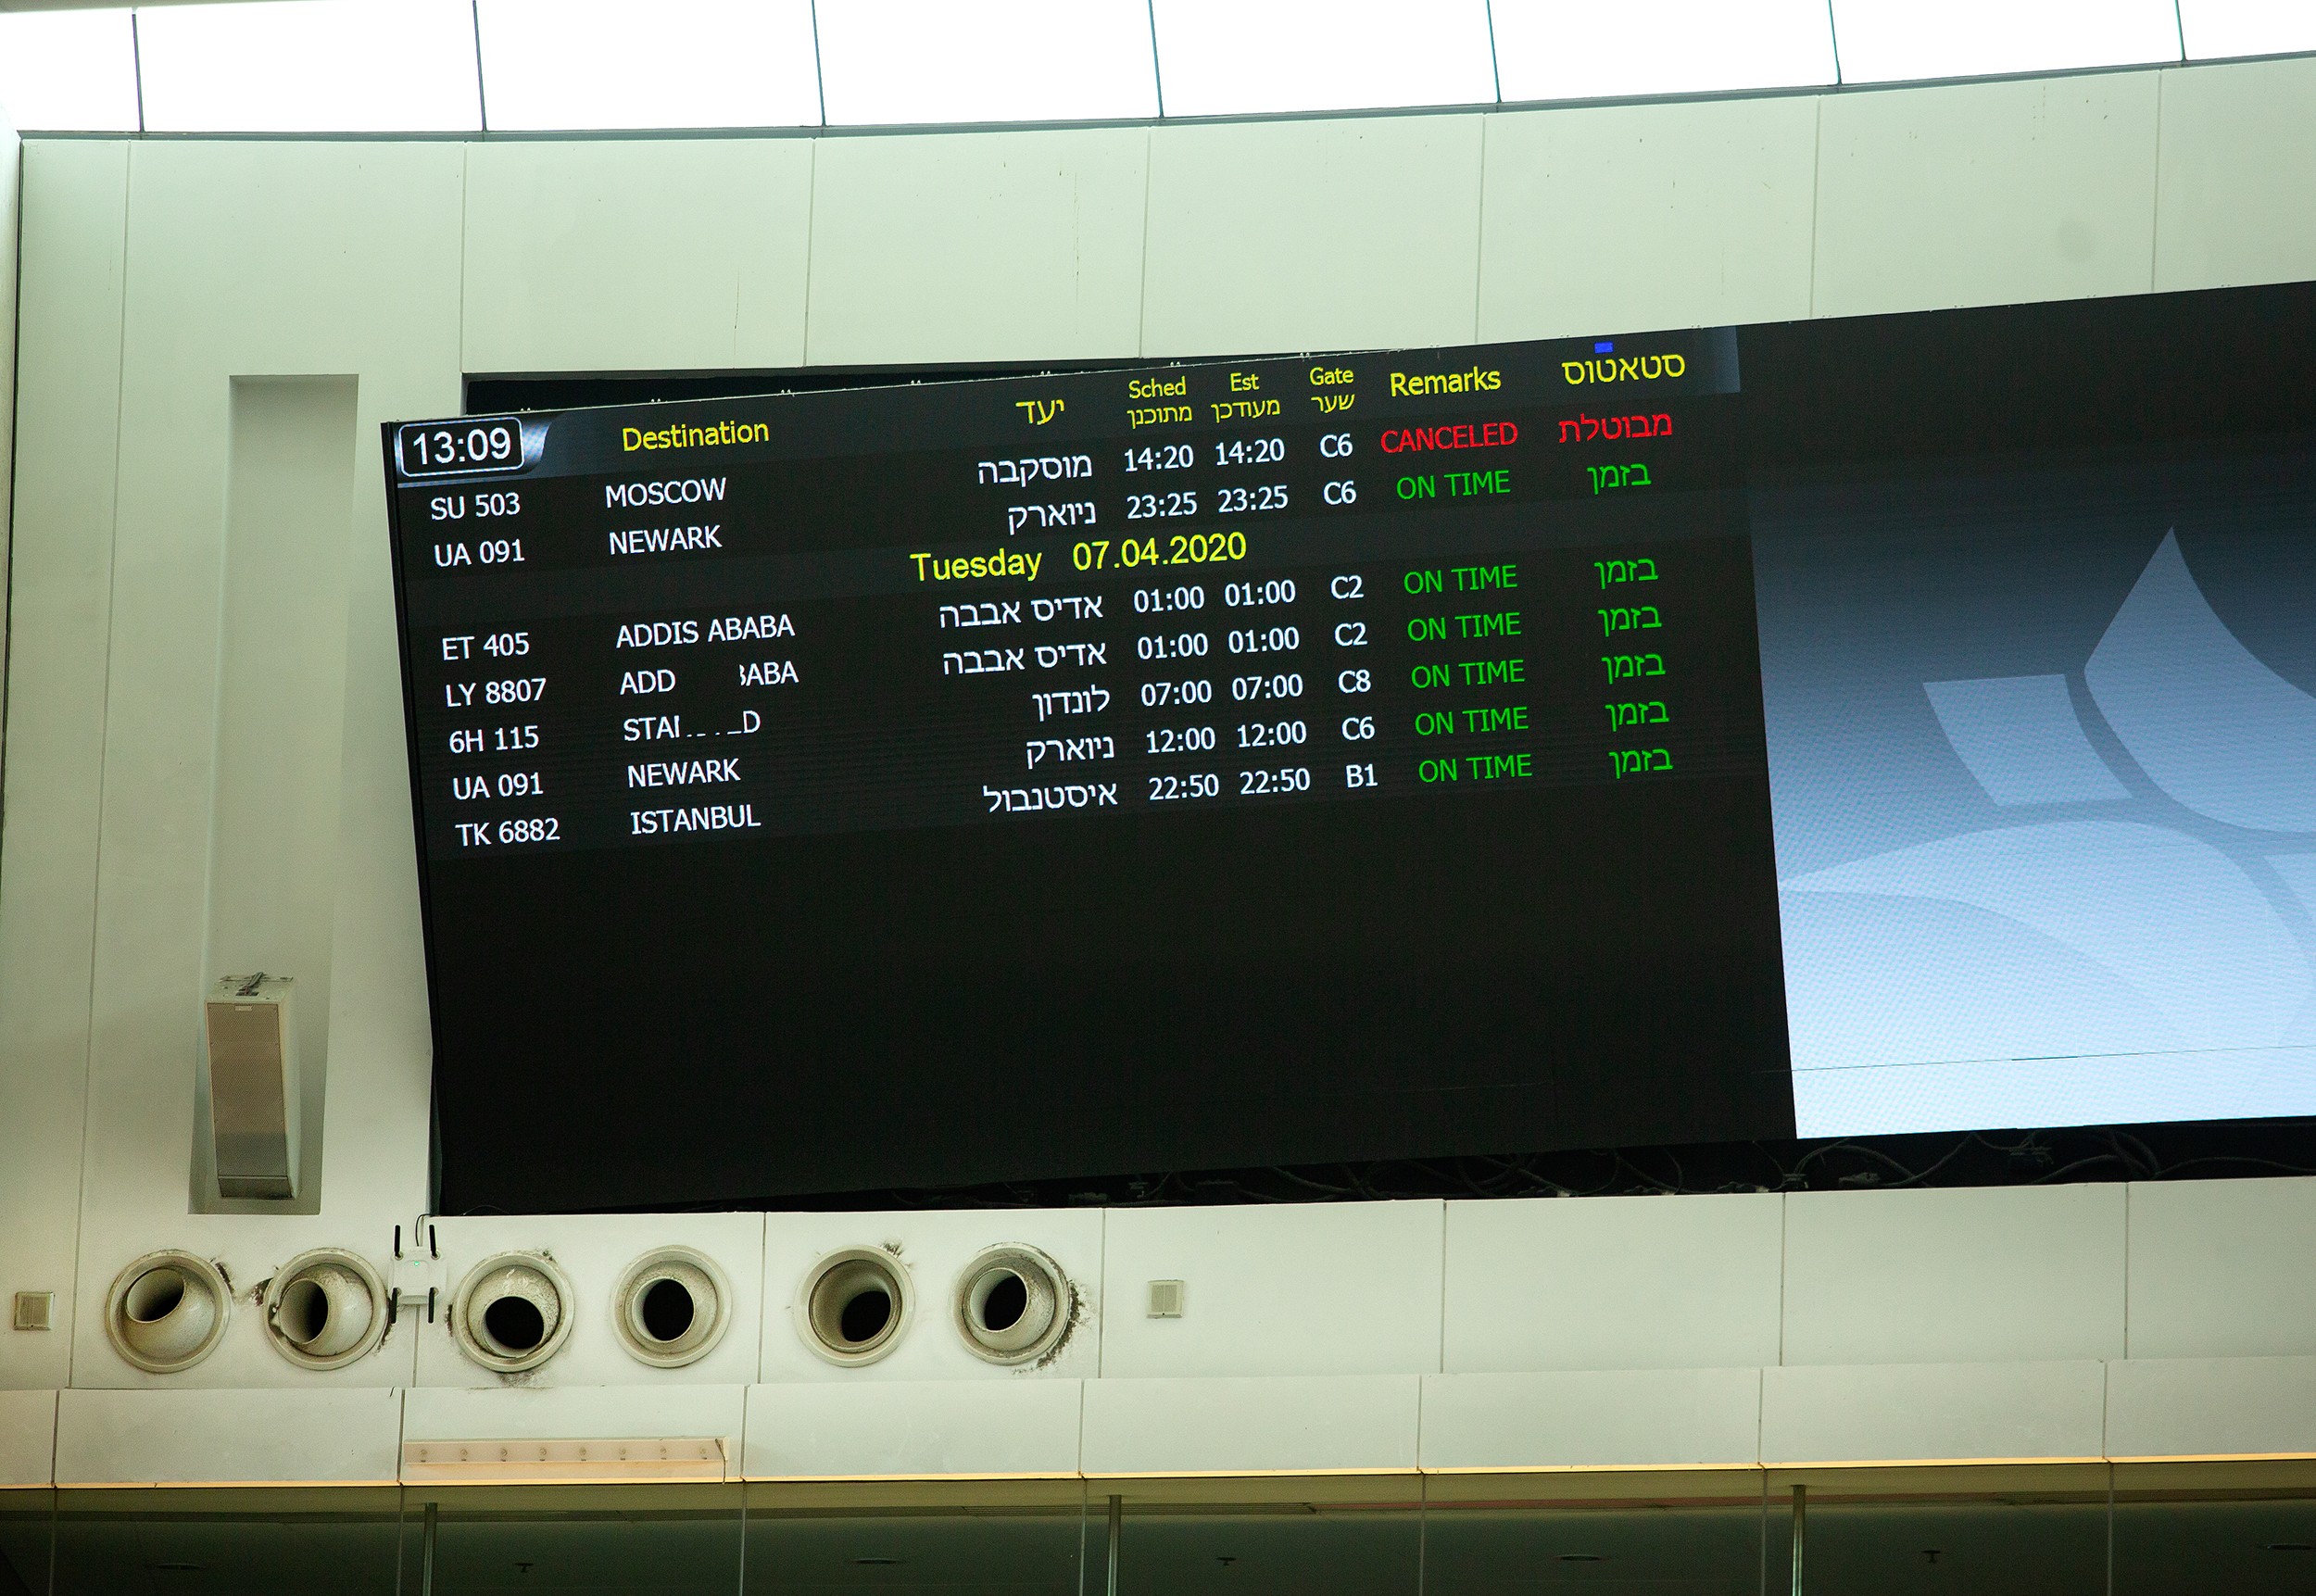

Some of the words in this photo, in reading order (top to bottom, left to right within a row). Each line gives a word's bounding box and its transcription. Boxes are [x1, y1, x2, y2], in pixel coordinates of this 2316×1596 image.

[1229, 371, 1260, 392] Est
[1309, 366, 1354, 386] Gate
[1390, 365, 1502, 397] Remarks
[1561, 353, 1686, 385] סטאטוס
[1127, 375, 1187, 399] Sched
[1014, 398, 1065, 426] יעד
[1126, 405, 1193, 430] מתוכנן
[1210, 398, 1281, 424] מעודכן
[1310, 393, 1355, 414] שער
[622, 420, 770, 452] Destination
[1380, 421, 1518, 454] CANCELED
[1558, 412, 1673, 444] מבוטלת
[412, 427, 511, 465] 13:09
[1124, 444, 1194, 472] 14:20
[1215, 437, 1286, 466] 14:20
[1319, 433, 1353, 459] C6
[977, 454, 1093, 488] מוסקבה
[1396, 474, 1436, 500] ON
[1443, 470, 1511, 497] TIME
[1586, 463, 1652, 496] בזמן
[430, 496, 466, 521] SU
[474, 491, 521, 518] 503
[605, 476, 727, 509] MOSCOW
[1127, 491, 1198, 520] 23:25
[1217, 484, 1289, 513] 23:25
[1323, 480, 1357, 506] C6
[1007, 501, 1097, 536] ניוארק
[434, 542, 472, 568] UA
[479, 538, 525, 564] 091
[609, 524, 724, 556] NEWARK
[909, 547, 1043, 582] Tuesday
[1072, 531, 1247, 572] 07.04.2020
[1330, 574, 1365, 600] C2
[1403, 570, 1443, 595] ON
[1450, 564, 1518, 592] TIME
[1593, 558, 1659, 590] בזמן
[1133, 585, 1205, 613] 01:00
[1224, 579, 1296, 607] 01:00
[938, 600, 1022, 629] אבבה
[1030, 595, 1104, 622] אדיס
[1597, 606, 1663, 637] בזמן
[615, 620, 699, 648] ADDIS
[707, 613, 796, 643] ABABA
[1227, 626, 1300, 654] 01:00
[1334, 622, 1368, 647] C2
[1407, 617, 1447, 642] ON
[1454, 611, 1522, 638] TIME
[442, 635, 475, 661] ET
[483, 632, 530, 658] 405
[942, 647, 1026, 675] אבבה
[1034, 642, 1108, 669] אדיס
[1137, 633, 1209, 660] 01:00
[1338, 669, 1372, 694] C8
[1411, 663, 1451, 689] ON
[1457, 659, 1526, 685] TIME
[1601, 653, 1667, 685] בזמן
[445, 682, 477, 708] LY
[485, 677, 547, 705] 8807
[1140, 679, 1213, 707] 07:00
[1231, 672, 1303, 701] 07:00
[1031, 684, 1111, 723] לונדון
[1605, 700, 1670, 733] בזמן
[1237, 720, 1307, 748] 12:00
[1341, 715, 1376, 741] C6
[1415, 710, 1454, 736] ON
[1461, 706, 1529, 733] TIME
[448, 728, 485, 754] 6H
[494, 724, 540, 751] 115
[1026, 735, 1115, 770] ניוארק
[1146, 726, 1216, 754] 12:00
[627, 758, 742, 788] NEWARK
[1345, 763, 1378, 788] B1
[1418, 758, 1457, 783] ON
[1465, 753, 1533, 780] TIME
[1608, 748, 1674, 779] בזמן
[452, 775, 491, 800] UA
[497, 772, 544, 798] 091
[1148, 773, 1220, 801] 22:50
[1240, 767, 1311, 796] 22:50
[982, 783, 1118, 813] איסטנבול
[454, 822, 492, 847] TK
[498, 817, 561, 844] 6882
[630, 803, 762, 836] ISTANBUL
